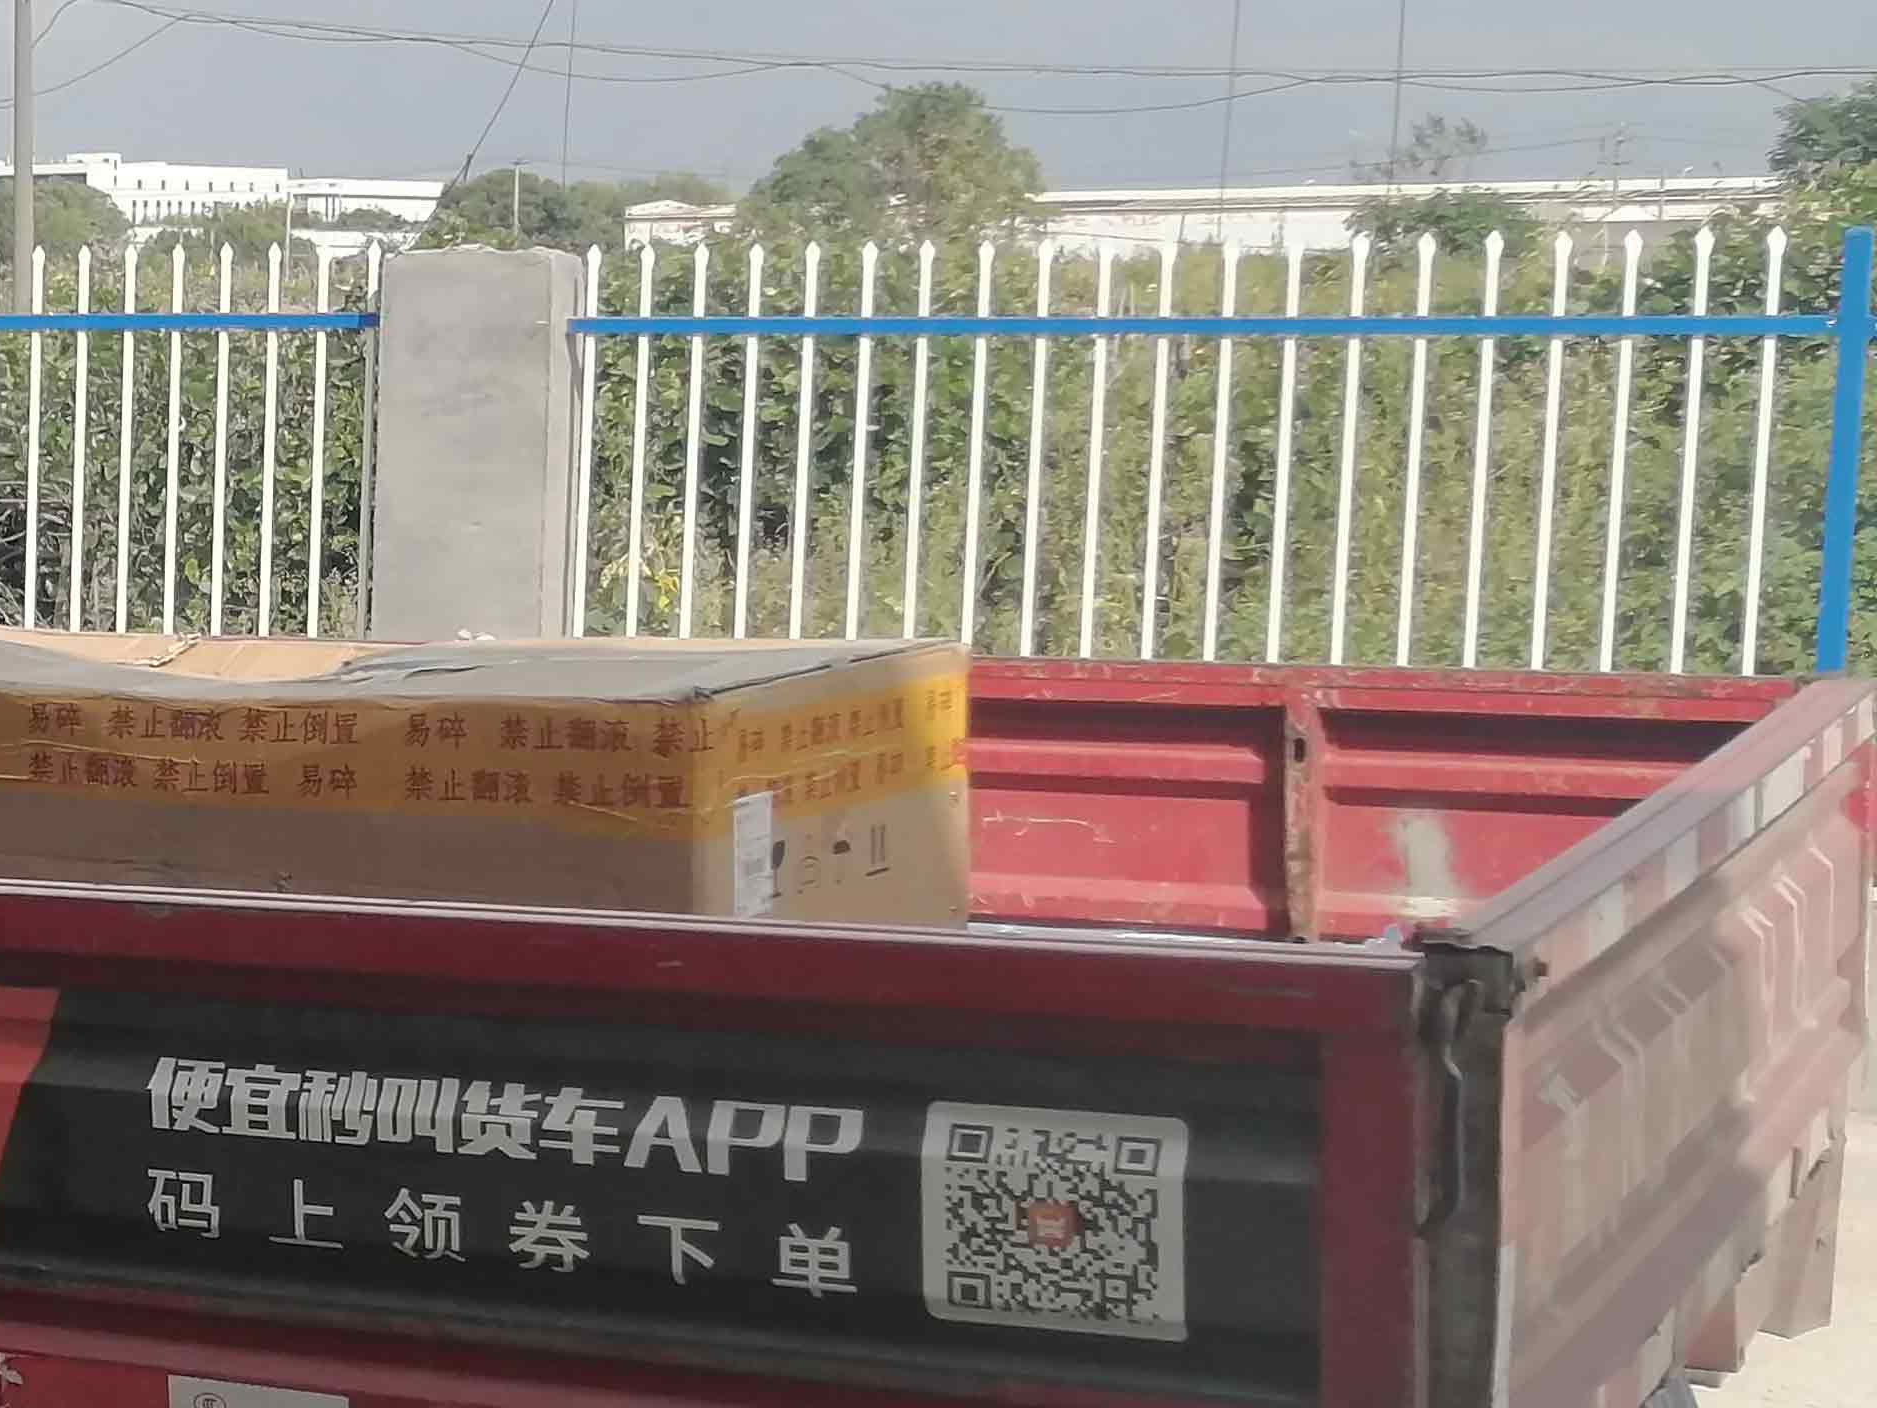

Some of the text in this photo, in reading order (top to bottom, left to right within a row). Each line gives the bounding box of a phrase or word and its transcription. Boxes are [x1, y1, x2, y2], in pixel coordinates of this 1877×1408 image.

[28, 701, 85, 737] 易碎
[238, 707, 360, 745] 禁止倒置
[404, 711, 470, 749] 易碎
[153, 759, 269, 794] 禁止倒置
[298, 764, 359, 799] 易碎
[146, 1055, 864, 1183] 便宜秒叫货车APP
